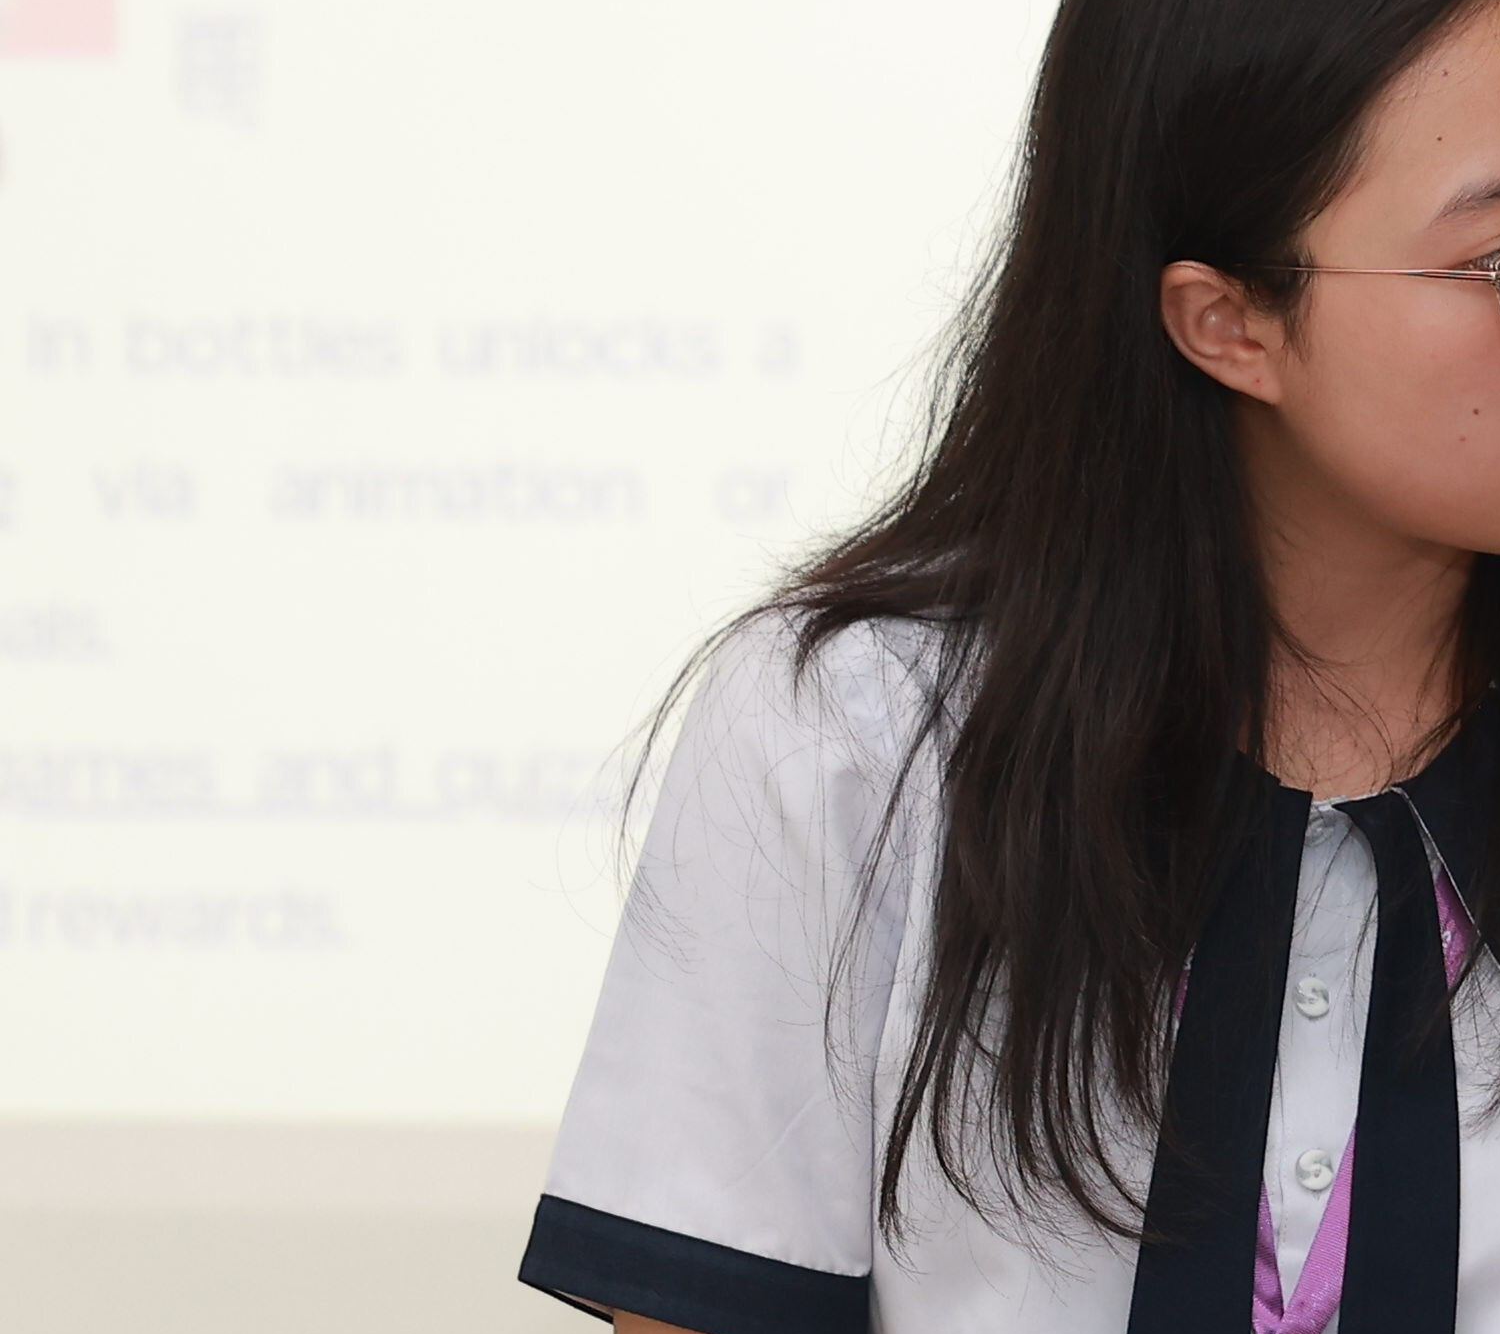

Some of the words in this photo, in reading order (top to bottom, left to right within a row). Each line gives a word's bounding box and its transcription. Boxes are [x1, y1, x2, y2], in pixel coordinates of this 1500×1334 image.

[122, 312, 407, 378] bottles
[433, 312, 722, 378] unlocks
[91, 458, 198, 522] via
[269, 456, 647, 524] animation
